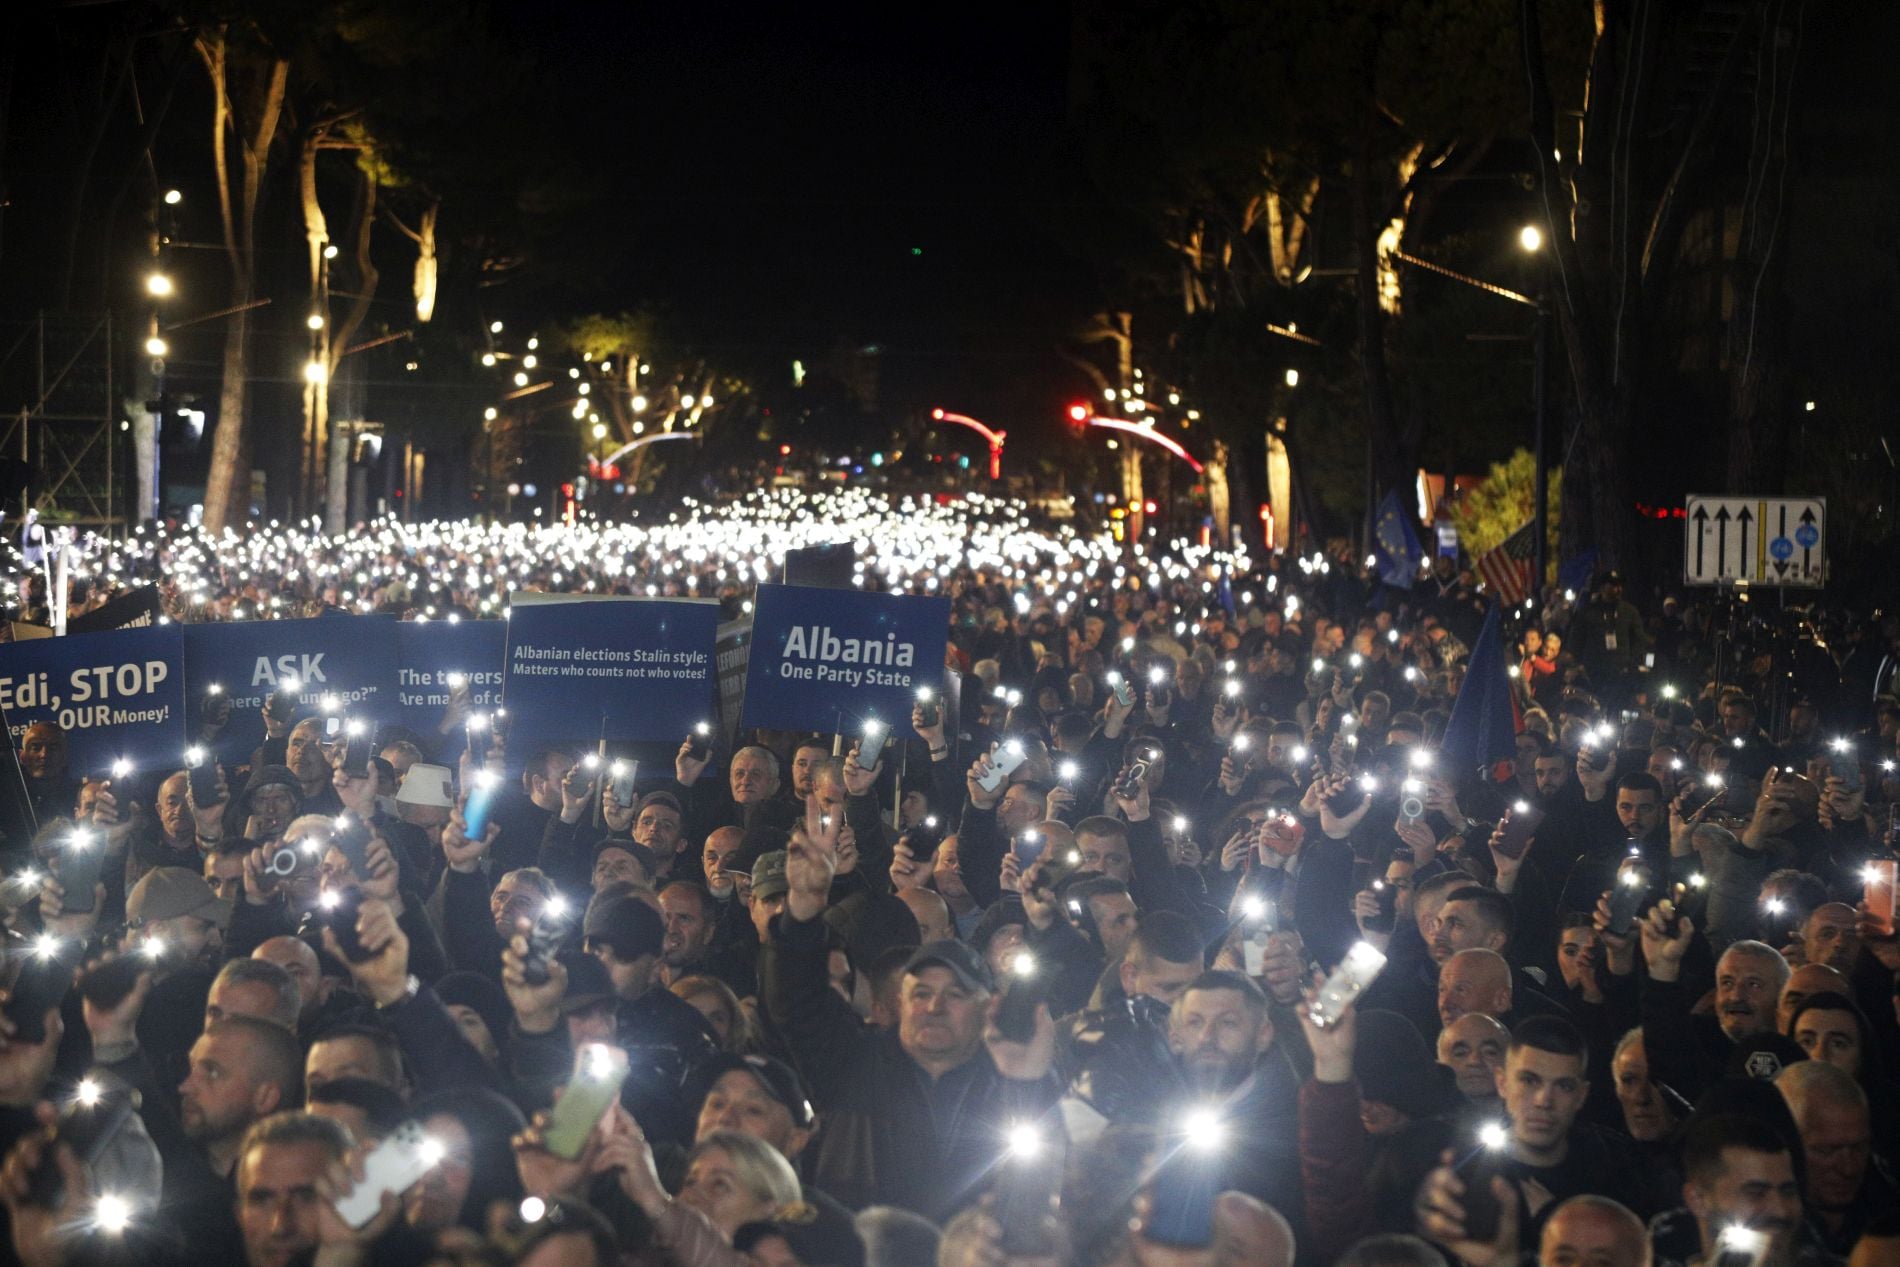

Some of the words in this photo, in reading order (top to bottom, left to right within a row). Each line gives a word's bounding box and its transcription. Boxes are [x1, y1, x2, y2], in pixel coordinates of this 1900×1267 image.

[514, 645, 571, 661] Albanian
[574, 647, 631, 662] elections
[633, 649, 671, 664] Stalin
[673, 650, 708, 667] style:
[782, 625, 915, 668] Albania
[251, 652, 327, 686] ASK
[398, 668, 432, 686] The
[513, 663, 559, 676] Matters
[561, 665, 584, 677] who
[586, 666, 624, 678] counts
[625, 668, 646, 679] not
[647, 667, 671, 679] who
[673, 668, 706, 680] votes!
[780, 662, 813, 679] One
[817, 664, 862, 688] Party
[865, 668, 912, 687] State
[0, 673, 61, 712] Edi,
[70, 660, 168, 702] STOP
[400, 692, 424, 706] Are
[473, 690, 490, 705] of
[59, 704, 111, 731] OUR
[113, 705, 169, 725] Money!
